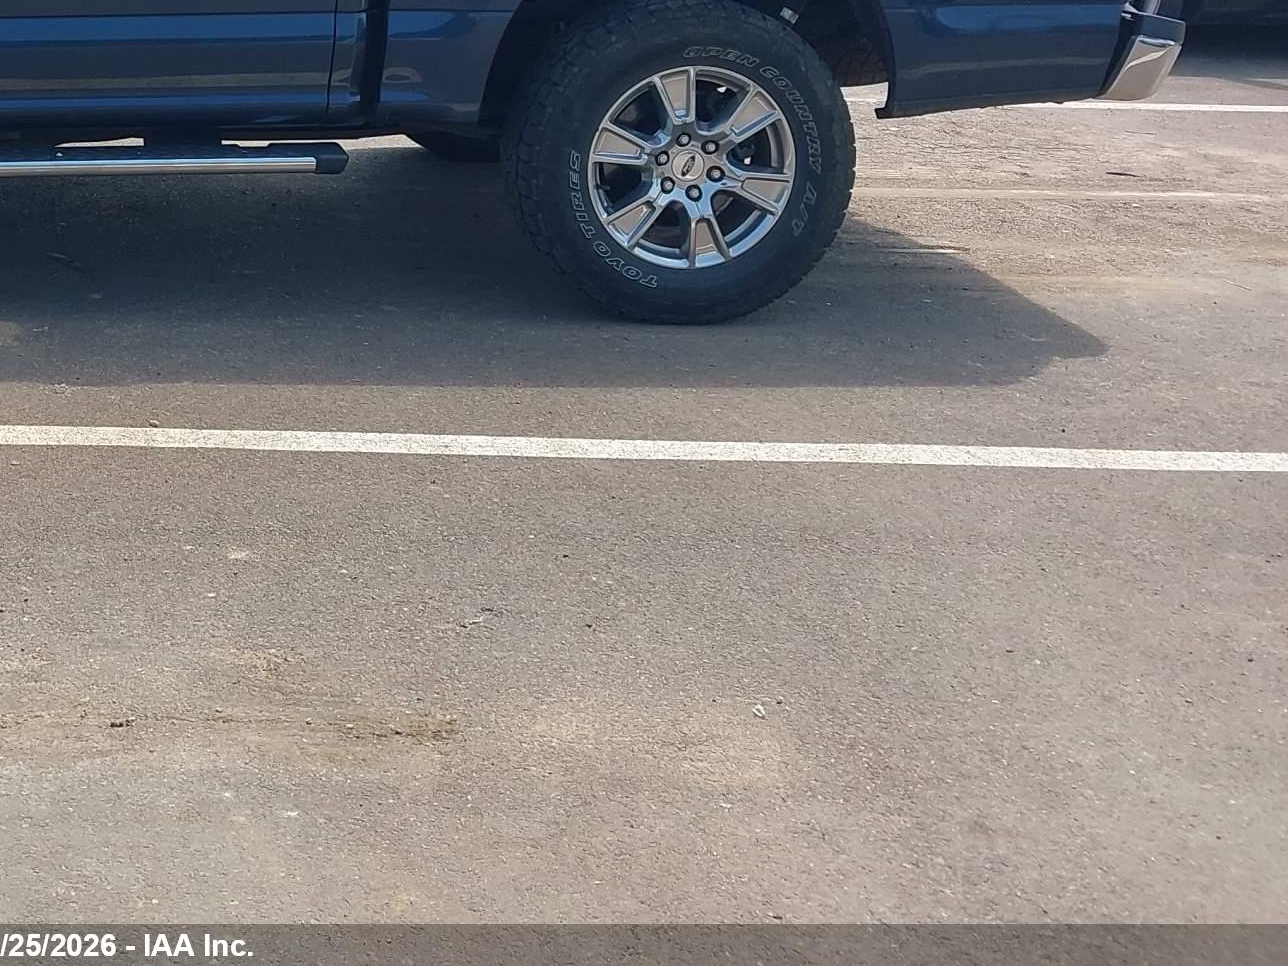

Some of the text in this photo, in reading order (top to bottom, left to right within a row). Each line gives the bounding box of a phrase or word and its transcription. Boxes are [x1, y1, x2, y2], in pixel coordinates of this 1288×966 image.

[682, 46, 760, 68] OPEN
[759, 66, 822, 175] COUNTRY
[569, 150, 658, 288] TOYO TIRES
